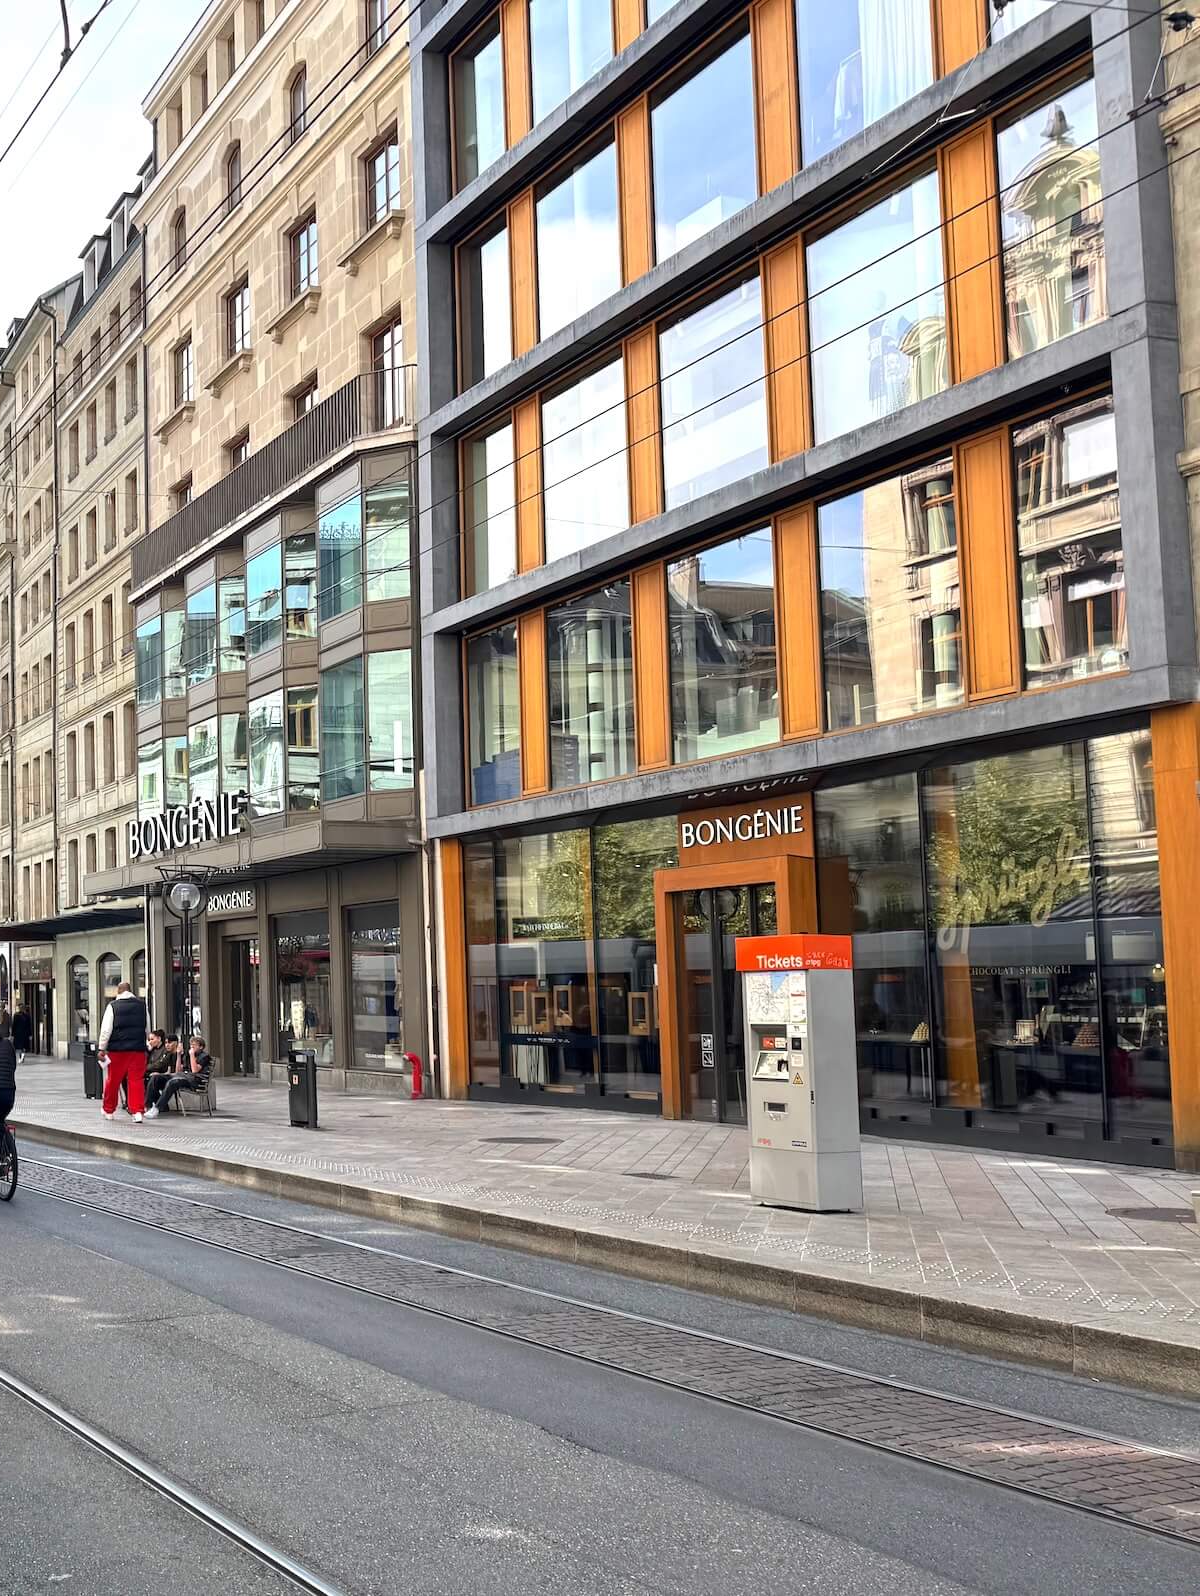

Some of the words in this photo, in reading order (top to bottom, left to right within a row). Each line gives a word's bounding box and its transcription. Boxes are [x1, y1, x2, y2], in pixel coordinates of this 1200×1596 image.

[129, 790, 243, 858] BONGÉNIE
[681, 805, 804, 848] BONGÉNIE
[208, 890, 251, 912] BONGÉNIE
[756, 954, 803, 969] Tickets
